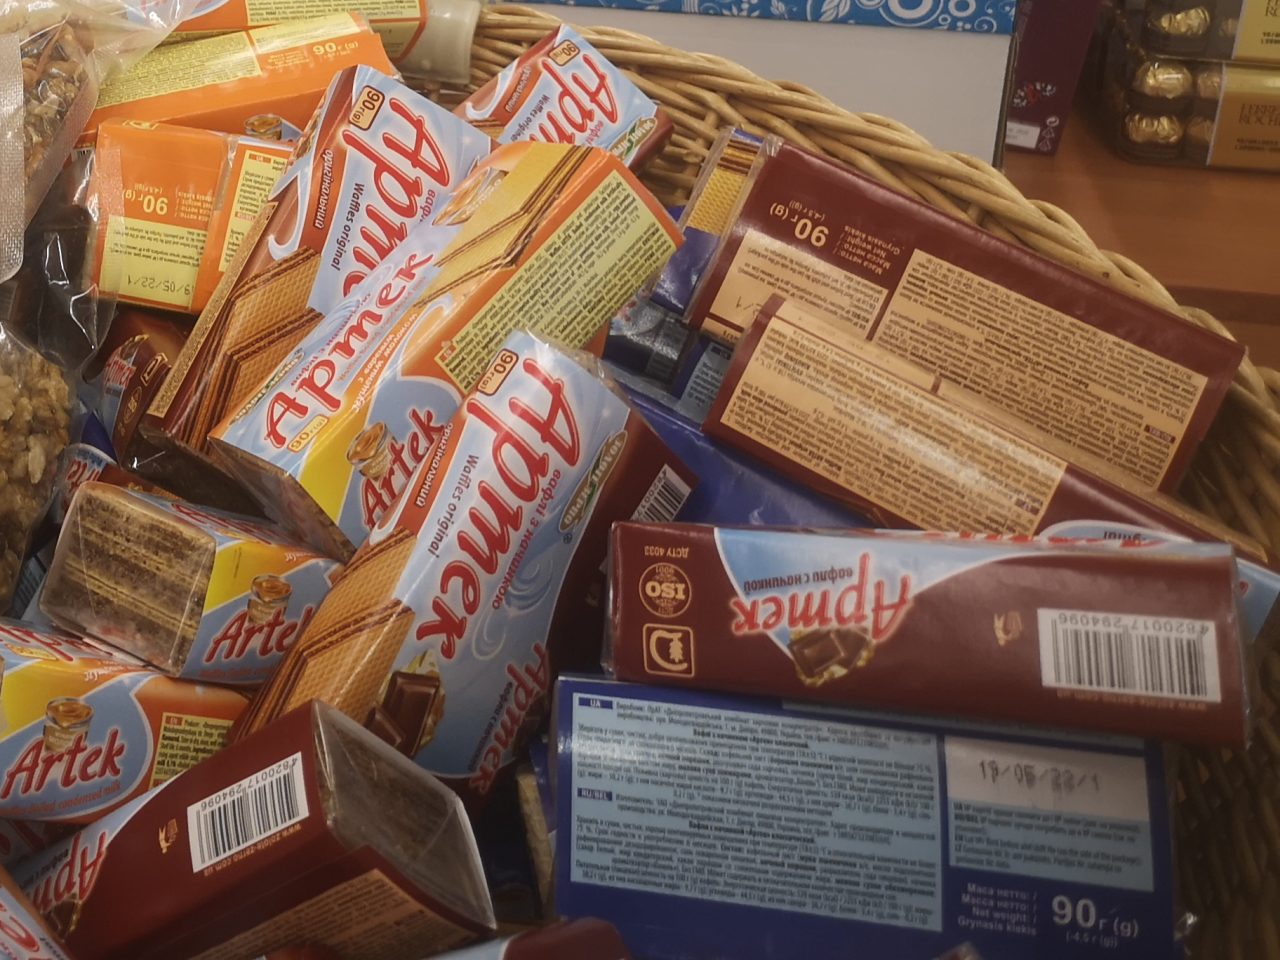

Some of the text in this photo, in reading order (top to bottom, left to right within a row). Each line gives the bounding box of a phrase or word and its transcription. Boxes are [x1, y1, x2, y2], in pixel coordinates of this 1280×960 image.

[330, 182, 365, 271] Waffles original
[455, 453, 479, 501] Waffles
[416, 357, 580, 660] Артек
[645, 581, 686, 601] ISO
[730, 552, 912, 642] Артек
[812, 565, 854, 585] вафли
[0, 728, 126, 800] Artek
[1112, 918, 1139, 938] (g)
